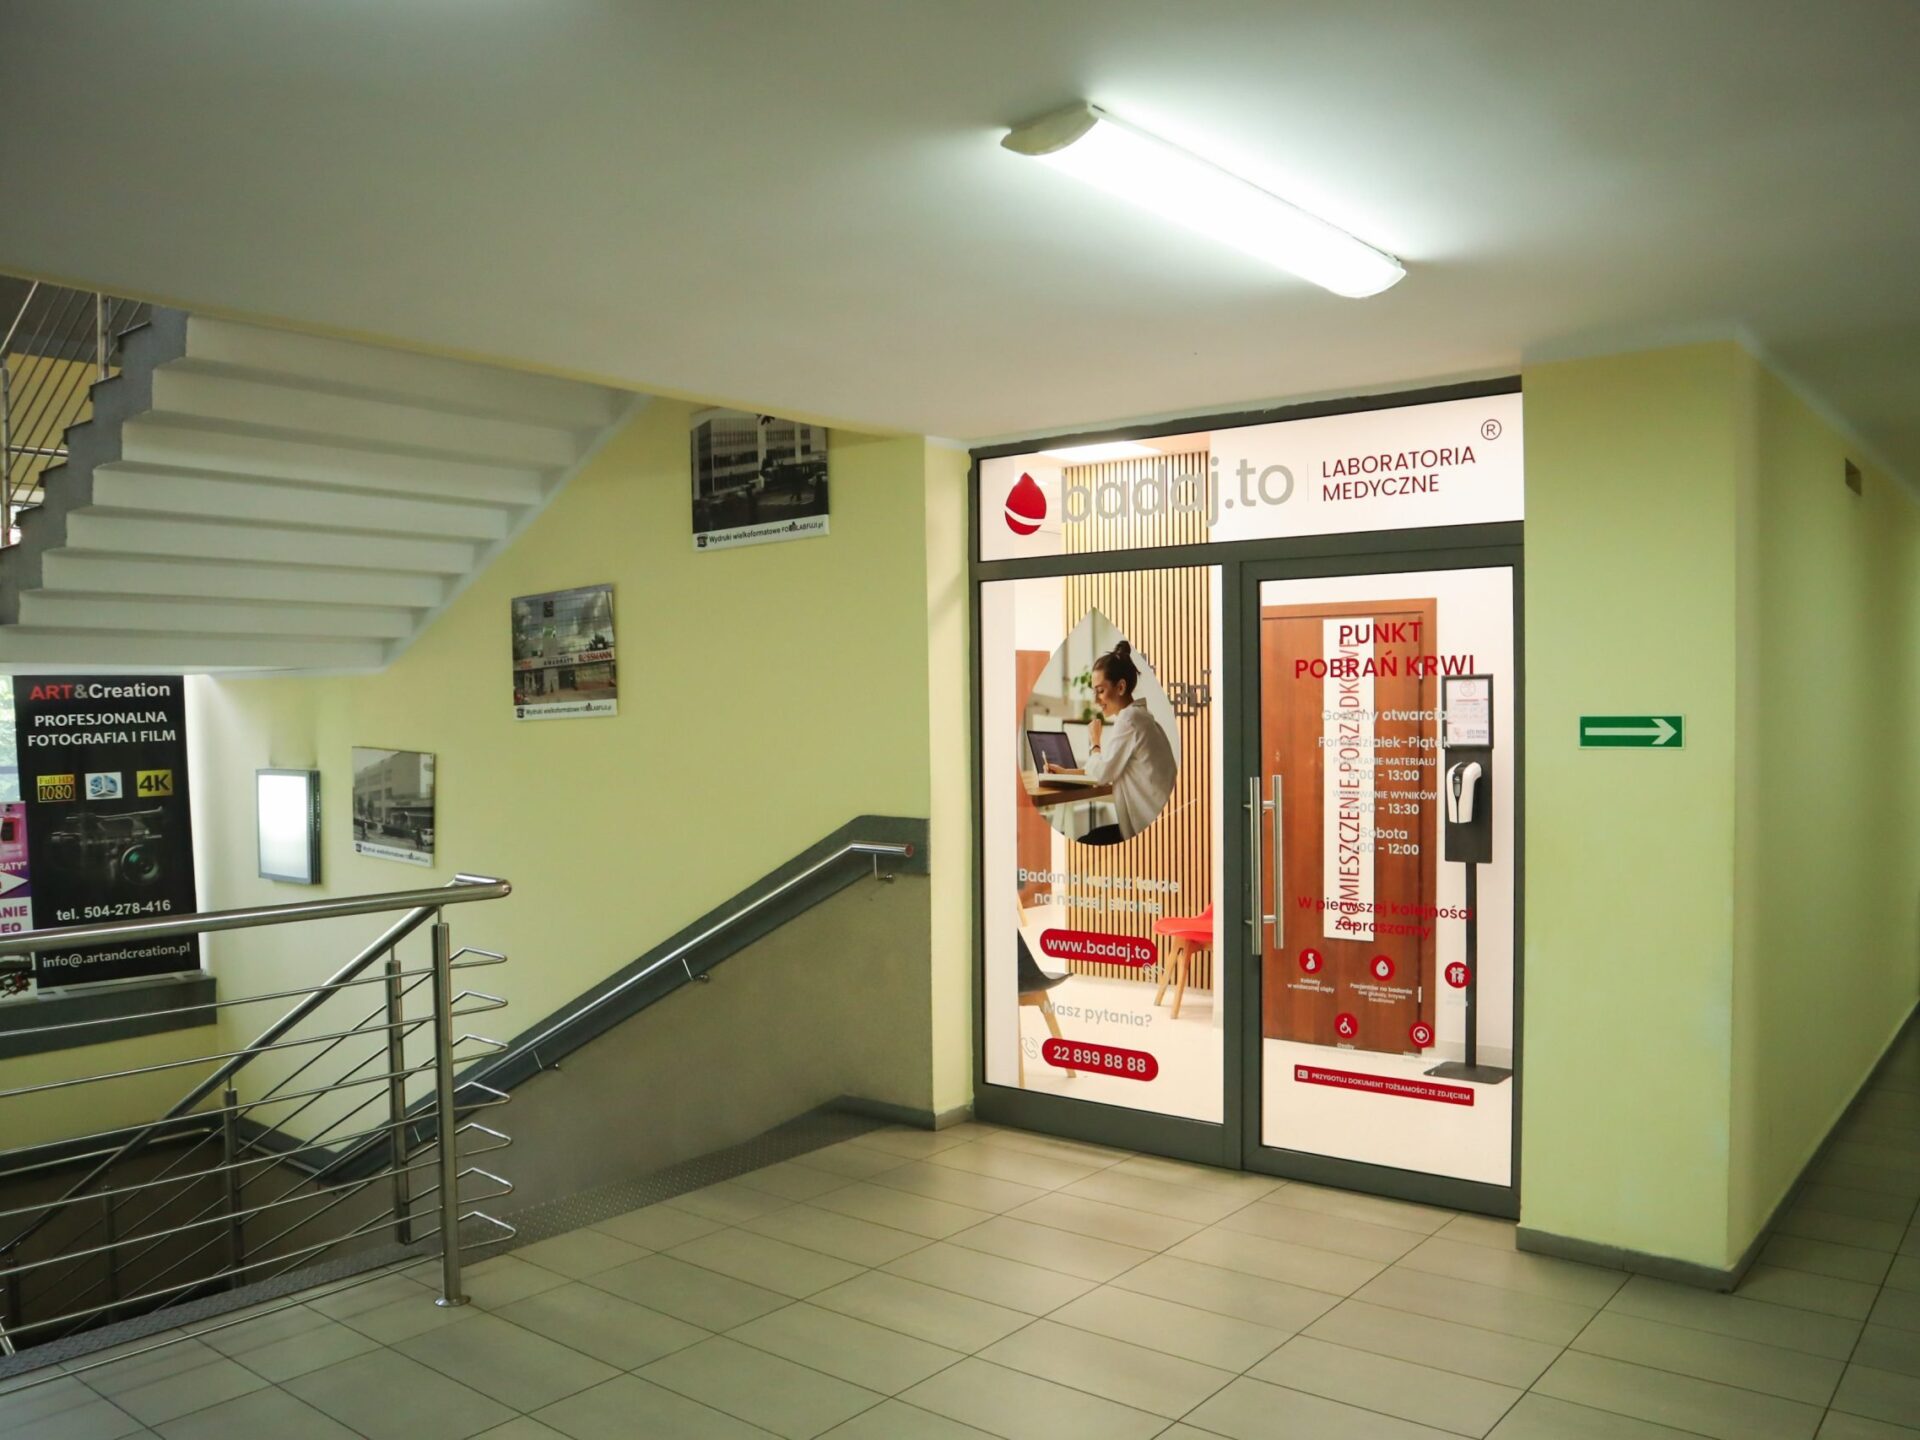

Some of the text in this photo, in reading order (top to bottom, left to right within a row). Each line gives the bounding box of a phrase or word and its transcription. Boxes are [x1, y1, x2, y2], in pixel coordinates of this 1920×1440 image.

[1321, 445, 1477, 479] LABORATORIA
[1060, 456, 1295, 527] badaj.to
[1321, 473, 1440, 502] MEDYCZNE
[1339, 621, 1423, 645] PUNKT
[1294, 650, 1474, 679] POBRAŃ KRWI
[30, 682, 171, 701] ART&Creation
[34, 711, 168, 727] PROFESJONALNA
[1382, 708, 1448, 721] otwarcia
[27, 729, 176, 747] FOTOGRAFIA I FILM
[1385, 757, 1436, 766] MATERIAŁU
[139, 774, 170, 792] 4K
[1388, 769, 1419, 781] 13:00
[40, 785, 72, 800] 1080
[1390, 789, 1438, 800] WYNIKÓW
[1388, 802, 1419, 815] 13:30
[1360, 827, 1408, 839] Sobota
[1388, 843, 1419, 855] 12:00
[1034, 891, 1050, 904] na
[56, 899, 171, 921] tel. 504-278-416
[1297, 896, 1473, 920] W pierwszej kolejności
[1335, 919, 1432, 939] zapraszamy
[43, 942, 191, 968] info@.artandcreation.pl
[1046, 937, 1151, 962] www.badaj.to
[1044, 1001, 1153, 1027] Masz pytania?
[1053, 1045, 1147, 1073] 22 899 88 88
[1311, 1072, 1471, 1101] PRZYGOTUJ DOKUMENT TOŻSAMOŚCI ZE ZDJĘCIEM
